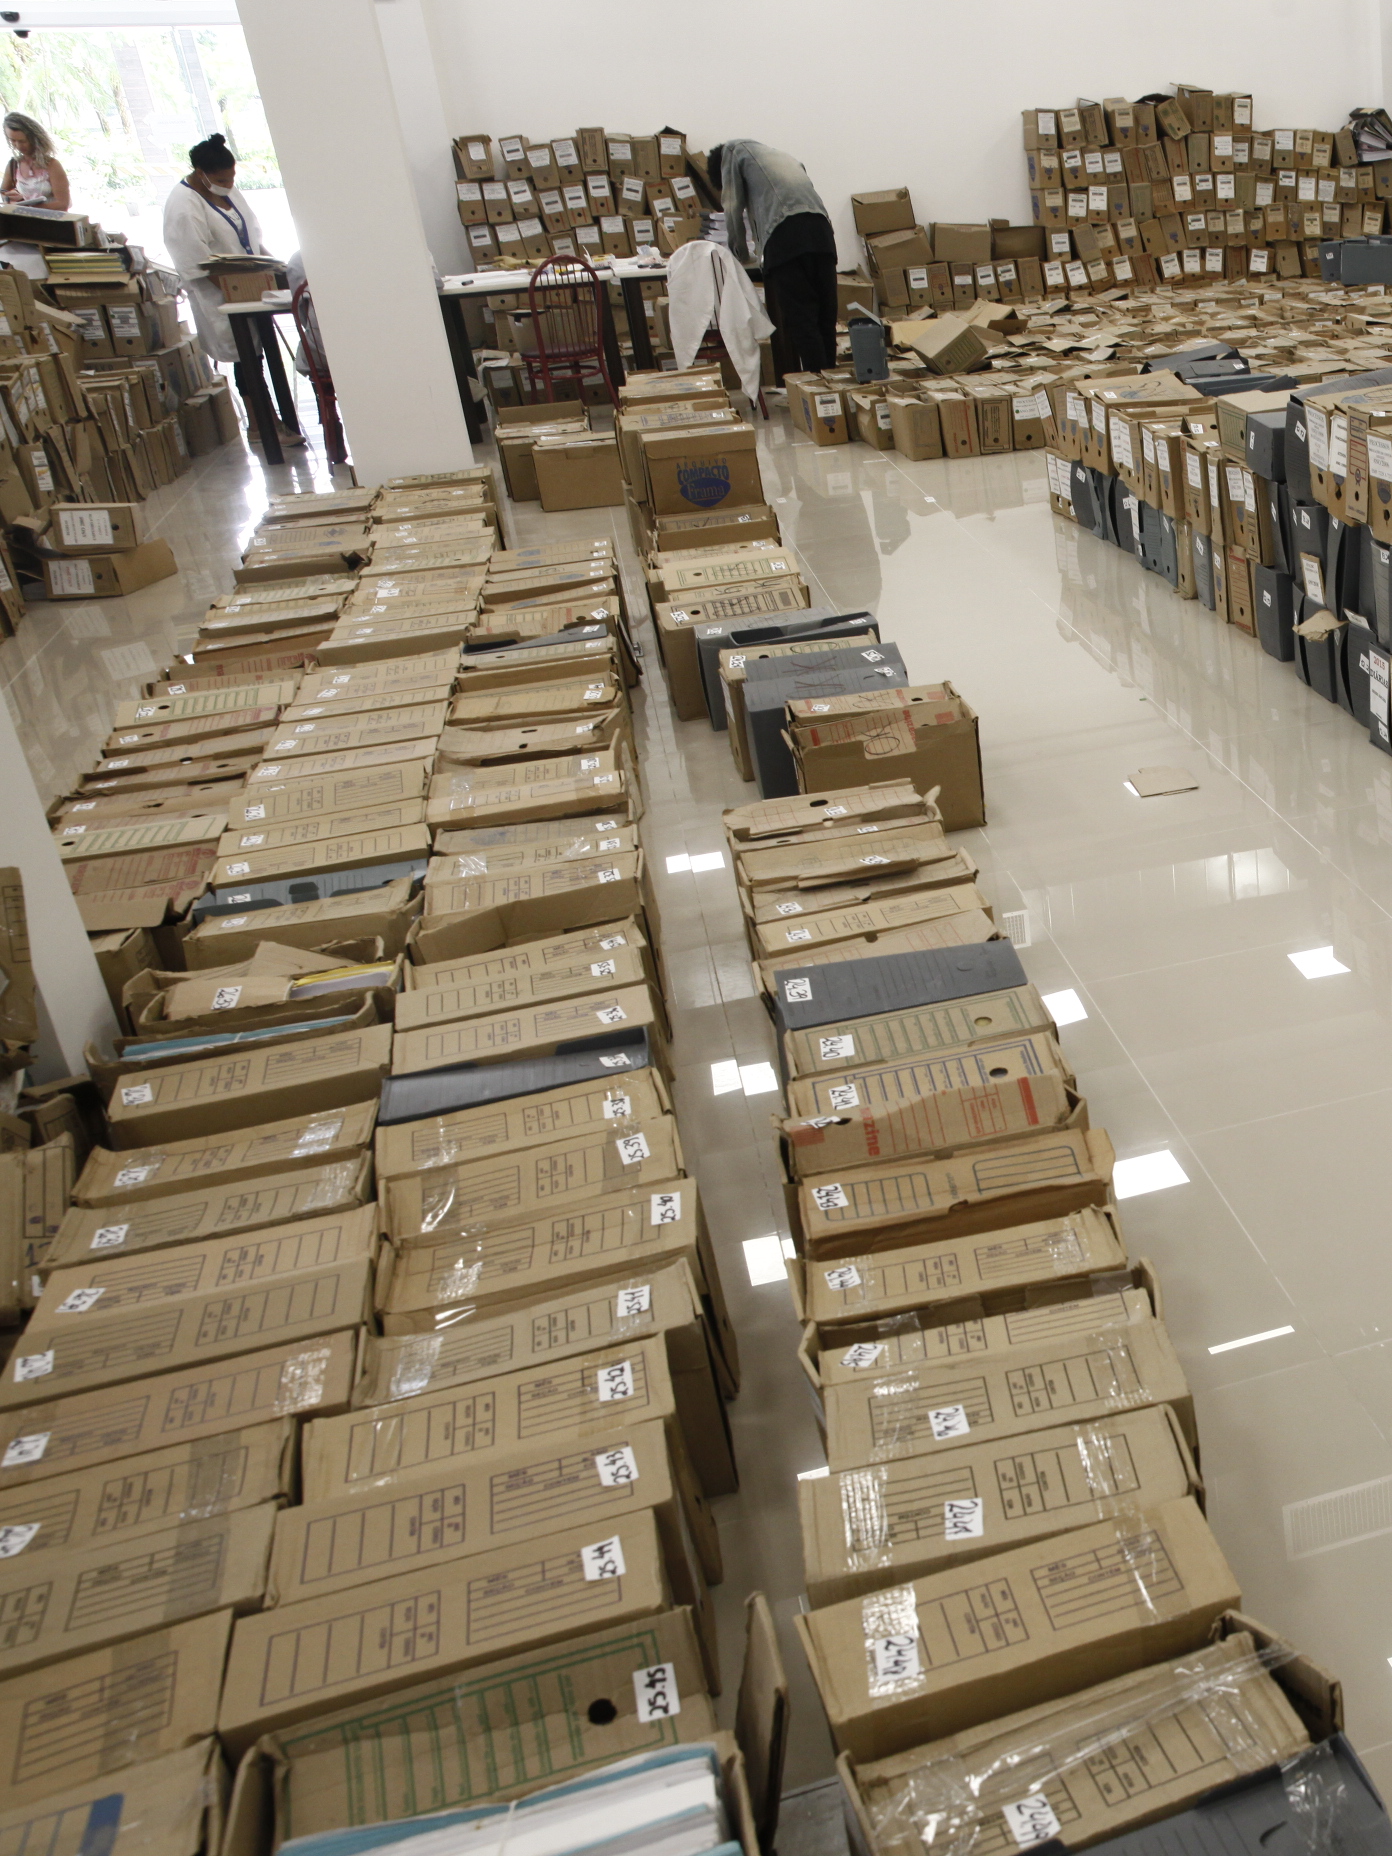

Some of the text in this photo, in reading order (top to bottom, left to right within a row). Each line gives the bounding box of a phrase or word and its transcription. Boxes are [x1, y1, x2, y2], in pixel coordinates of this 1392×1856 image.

[676, 457, 727, 470] ARQUIVO
[677, 465, 730, 486] COMPACTO
[686, 483, 725, 500] Frama
[1373, 655, 1386, 671] 2015
[785, 979, 808, 1000] 24.39
[624, 1135, 646, 1162] 25.39
[656, 1194, 676, 1224] 25.40
[626, 1287, 644, 1315] 25.41
[608, 1362, 626, 1399] 25.42
[604, 1450, 633, 1485] 25.43
[591, 1541, 618, 1578] 25.44
[648, 1666, 668, 1716] 25.45
